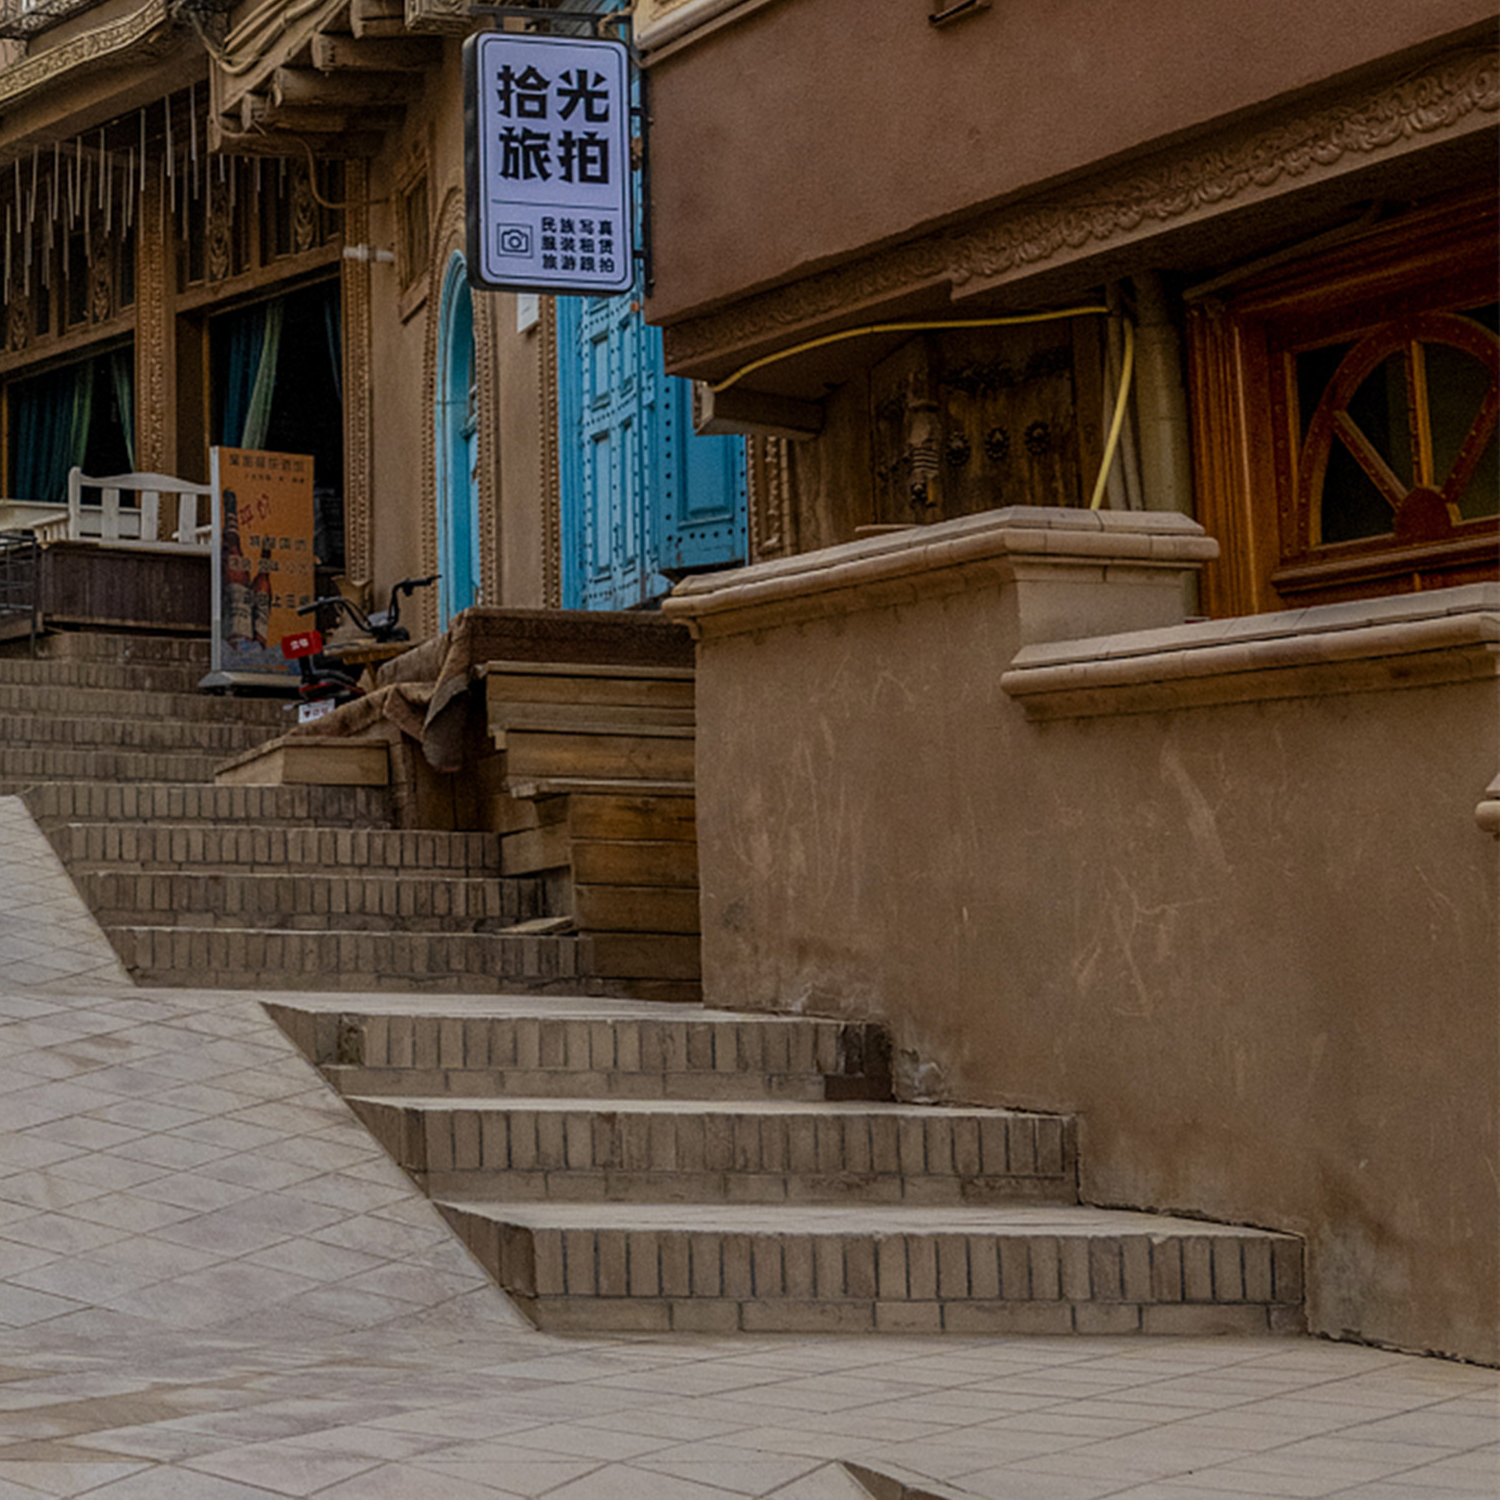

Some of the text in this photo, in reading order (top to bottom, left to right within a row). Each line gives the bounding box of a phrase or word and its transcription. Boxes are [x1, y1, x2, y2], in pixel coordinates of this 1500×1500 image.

[497, 64, 610, 123] 拾光
[499, 126, 610, 185] 旅拍
[541, 217, 613, 236] 民族写真
[541, 235, 613, 255] 服装租赁
[542, 253, 615, 273] 旅游跟拍
